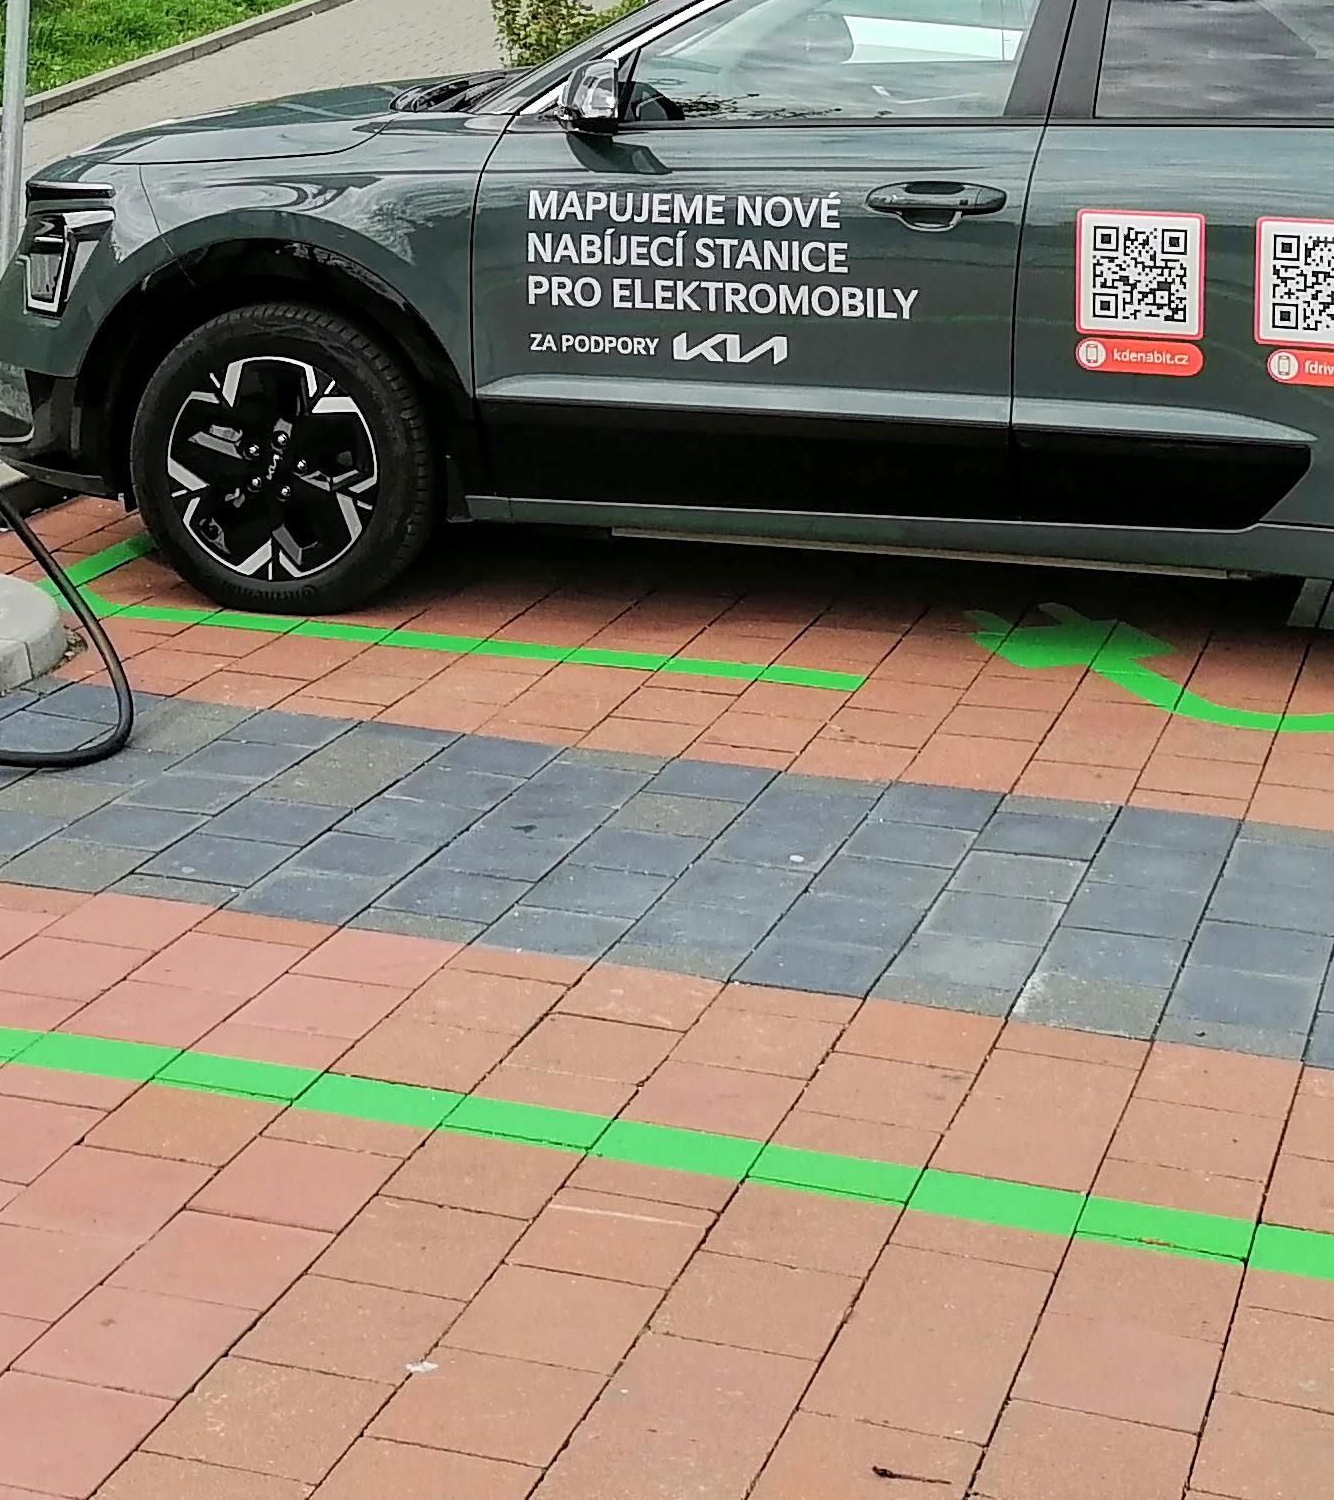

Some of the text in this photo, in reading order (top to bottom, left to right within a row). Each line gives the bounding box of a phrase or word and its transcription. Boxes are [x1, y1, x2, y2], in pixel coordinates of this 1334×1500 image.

[528, 189, 842, 229] MAPUJEME NOVÉ
[527, 228, 849, 274] NABÍJECÍ STANICE
[528, 275, 919, 320] PRO ELEKTROMOBILY
[529, 333, 558, 352] ZA
[561, 334, 660, 355] PODPORY
[1112, 347, 1190, 366] kdenabit.cz
